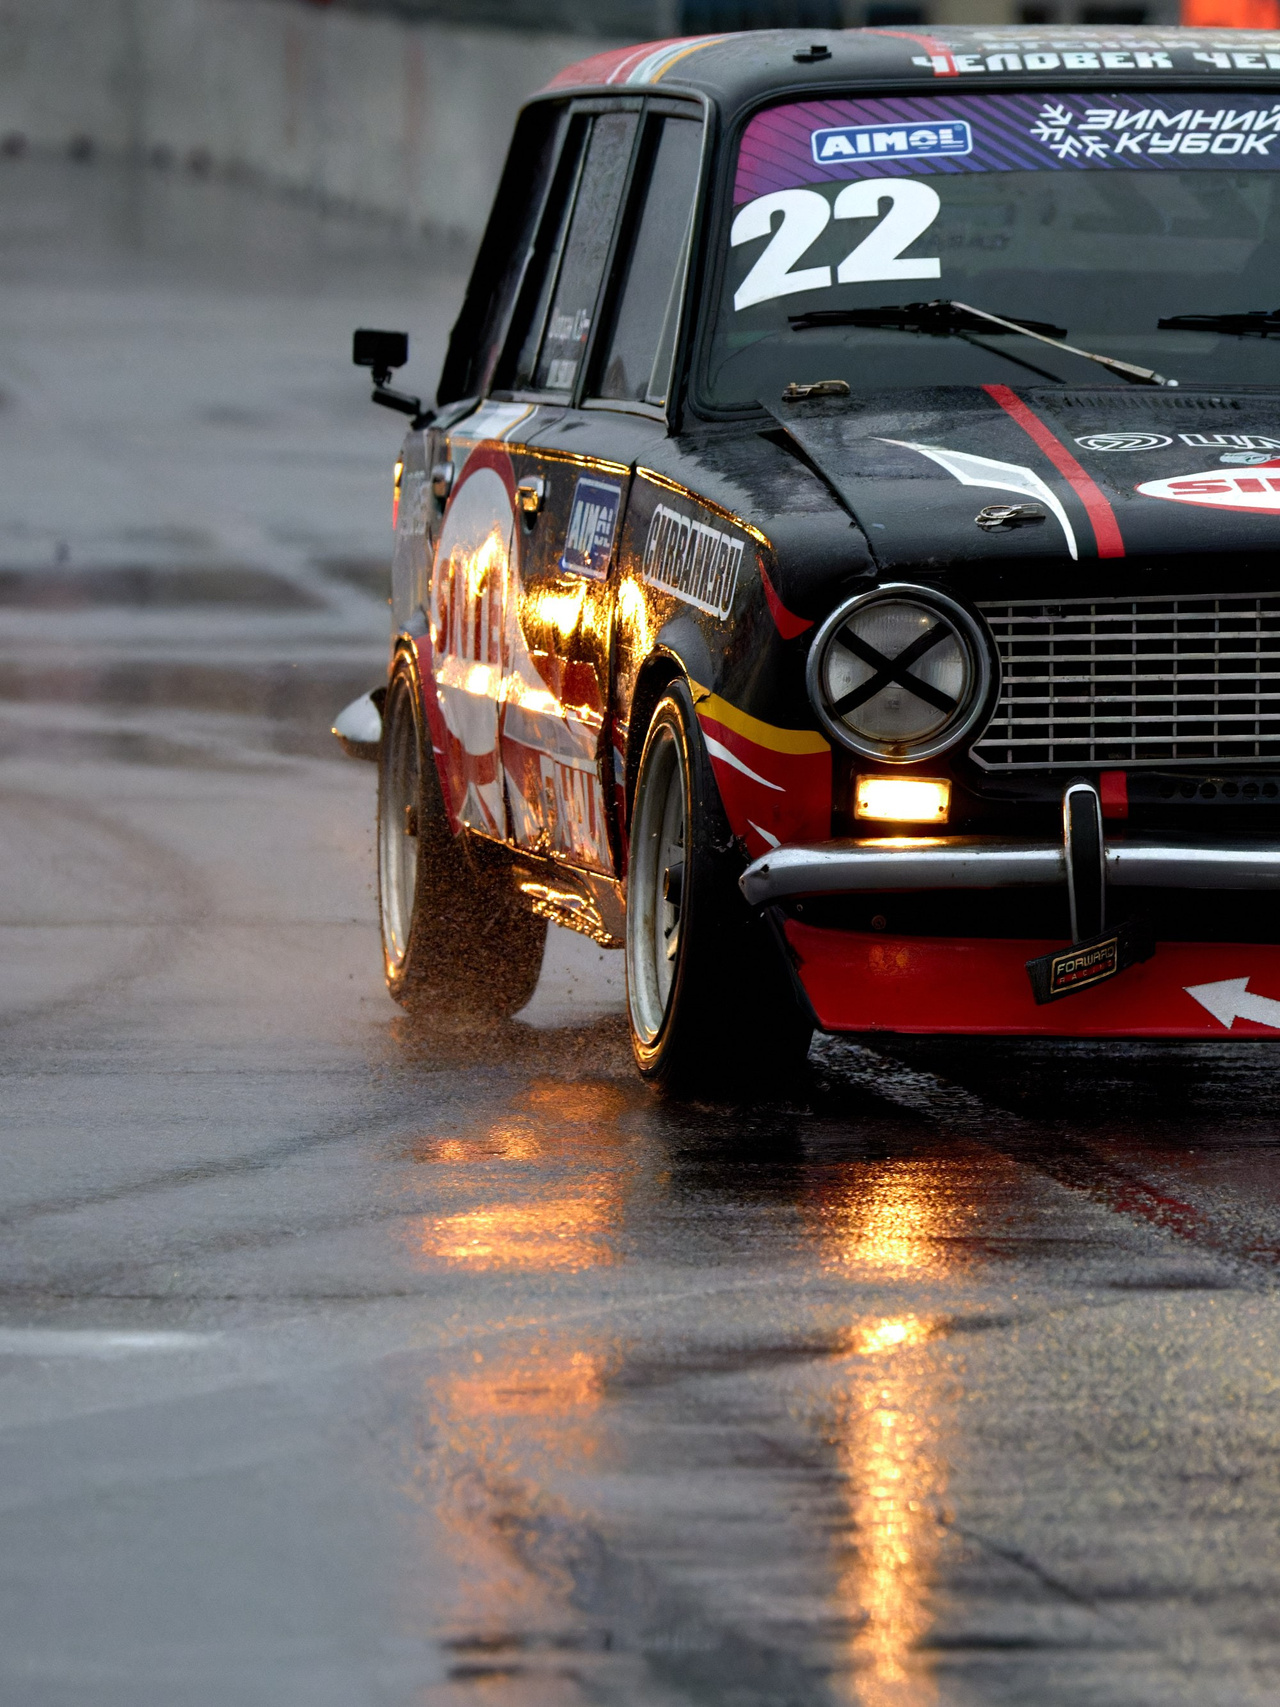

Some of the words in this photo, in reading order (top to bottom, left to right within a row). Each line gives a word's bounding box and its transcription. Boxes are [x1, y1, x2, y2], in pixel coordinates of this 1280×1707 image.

[912, 51, 1174, 73] ЧЕЛОВЕК
[820, 128, 965, 158] AIMOL
[1114, 132, 1278, 156] КУБОК
[730, 177, 941, 312] 22
[1056, 945, 1115, 975] FORWARD
